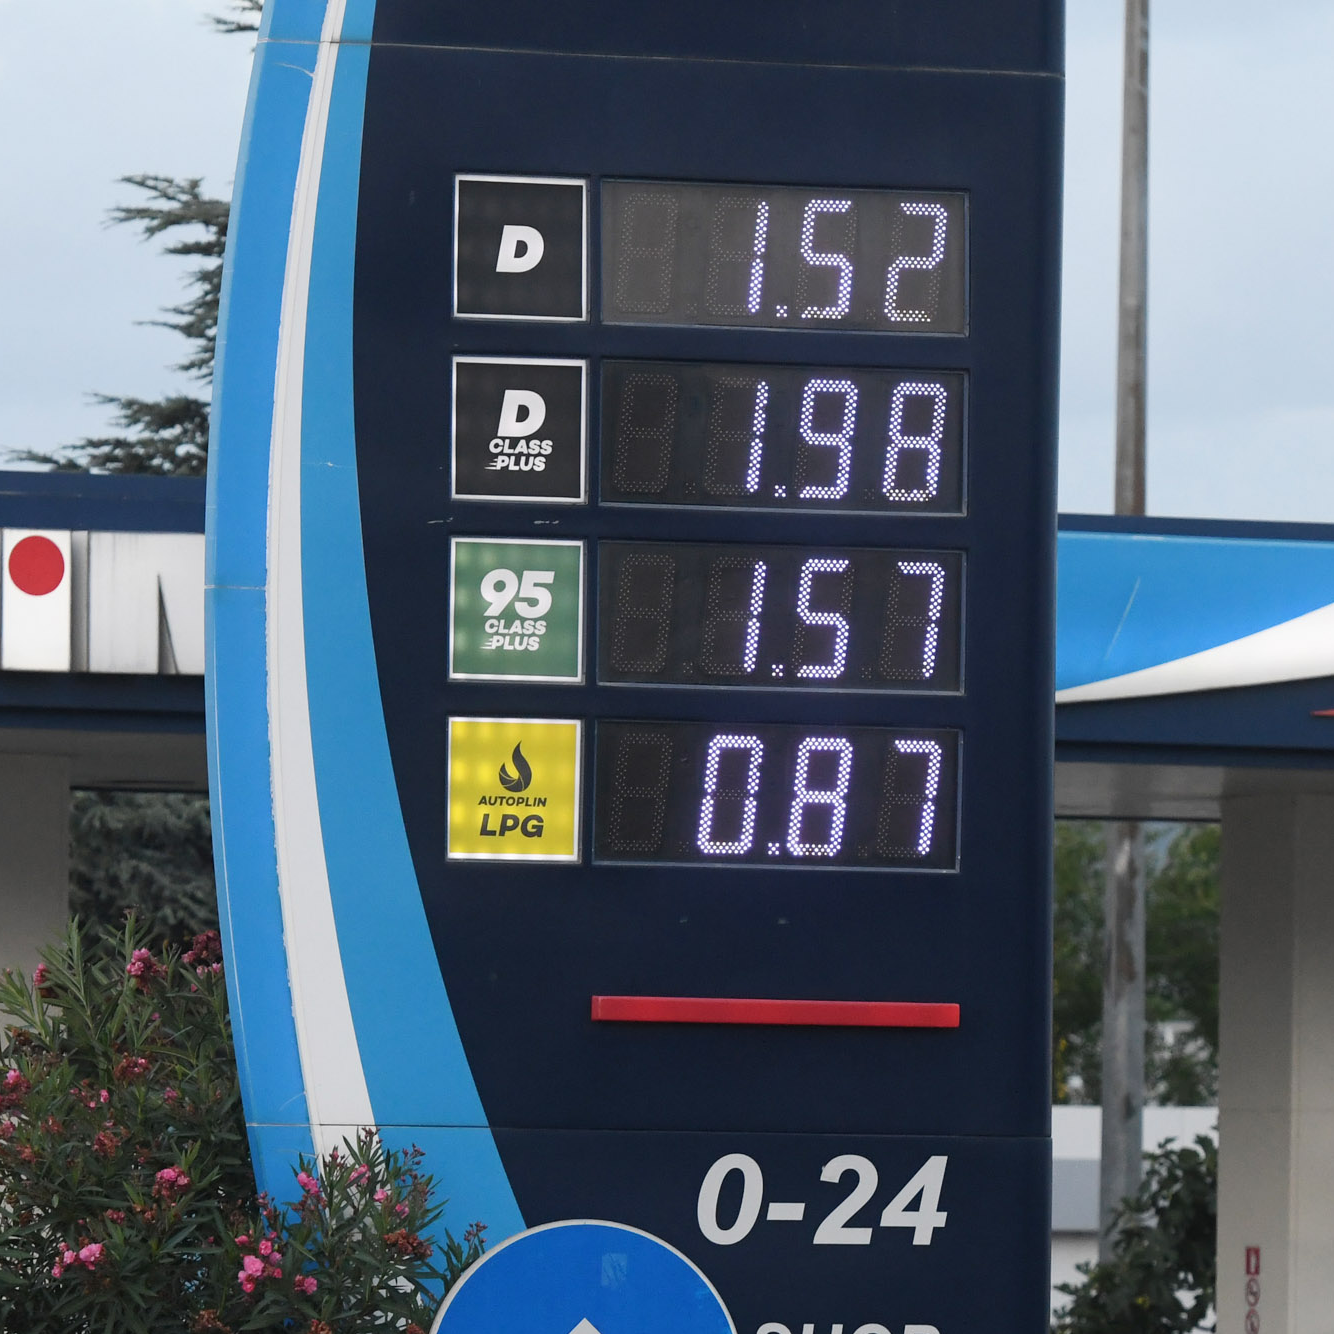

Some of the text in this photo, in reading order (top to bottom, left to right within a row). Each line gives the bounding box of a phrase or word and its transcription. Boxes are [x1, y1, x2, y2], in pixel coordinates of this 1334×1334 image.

[496, 225, 544, 273] D
[748, 200, 948, 322] 1.52
[497, 389, 546, 437] D
[488, 438, 553, 456] CLASS
[494, 456, 547, 473] PLUS
[746, 379, 948, 502] 1.98
[480, 568, 555, 619] 95
[484, 618, 547, 635] CLASS
[743, 558, 945, 678] 1.57
[490, 634, 541, 652] PLUS
[477, 795, 547, 808] AUTOPLIN
[696, 735, 942, 857] 0.87
[479, 813, 544, 838] LPG
[697, 1153, 948, 1246] 0-24
